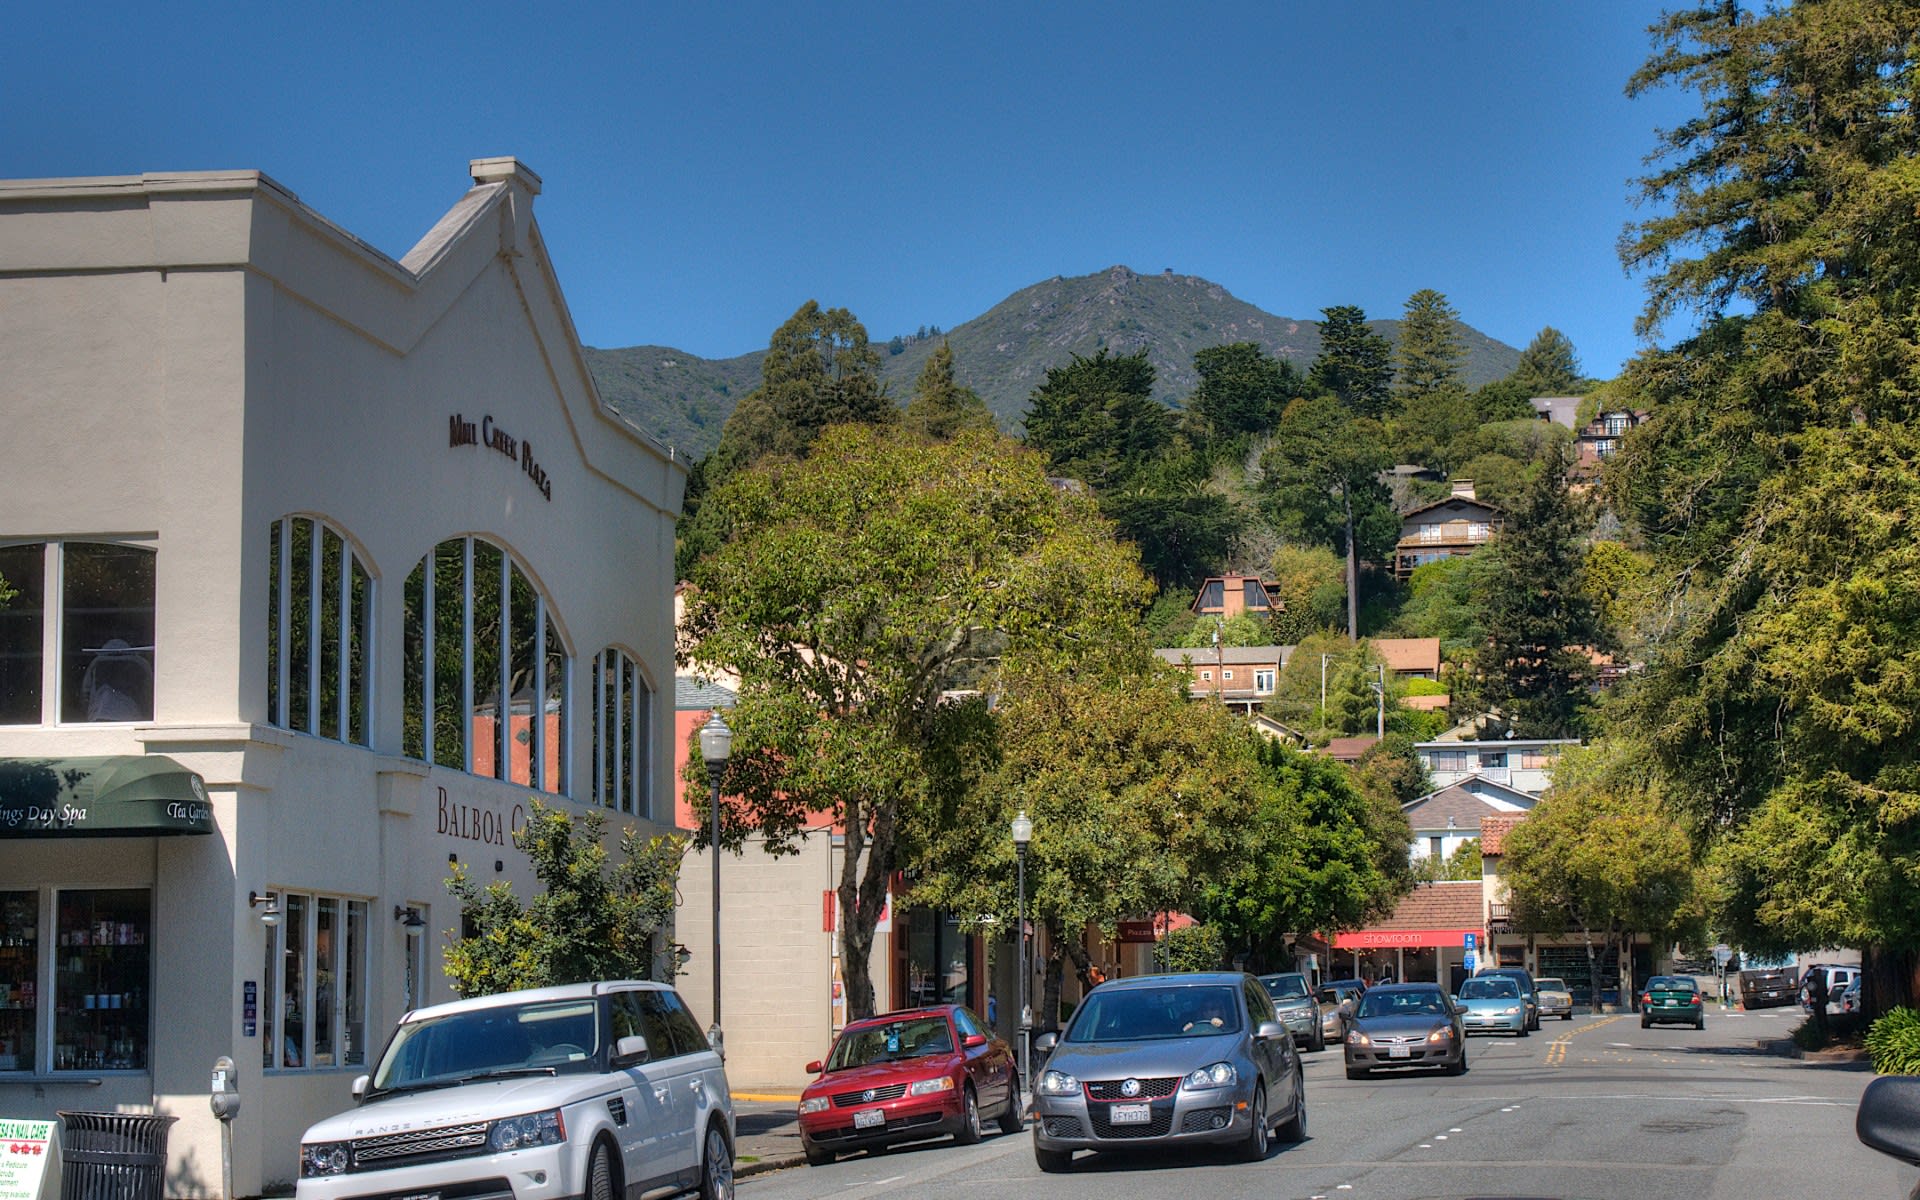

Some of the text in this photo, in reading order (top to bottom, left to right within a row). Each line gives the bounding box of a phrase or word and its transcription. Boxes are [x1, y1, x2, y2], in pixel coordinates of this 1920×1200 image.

[449, 413, 551, 501] MILL CREEK PLAZA
[27, 805, 57, 826] Day
[58, 803, 87, 826] Spa
[167, 802, 187, 819] Tea
[437, 786, 505, 846] BALBOA
[1363, 933, 1423, 945] showroom
[31, 1124, 48, 1140] CARE
